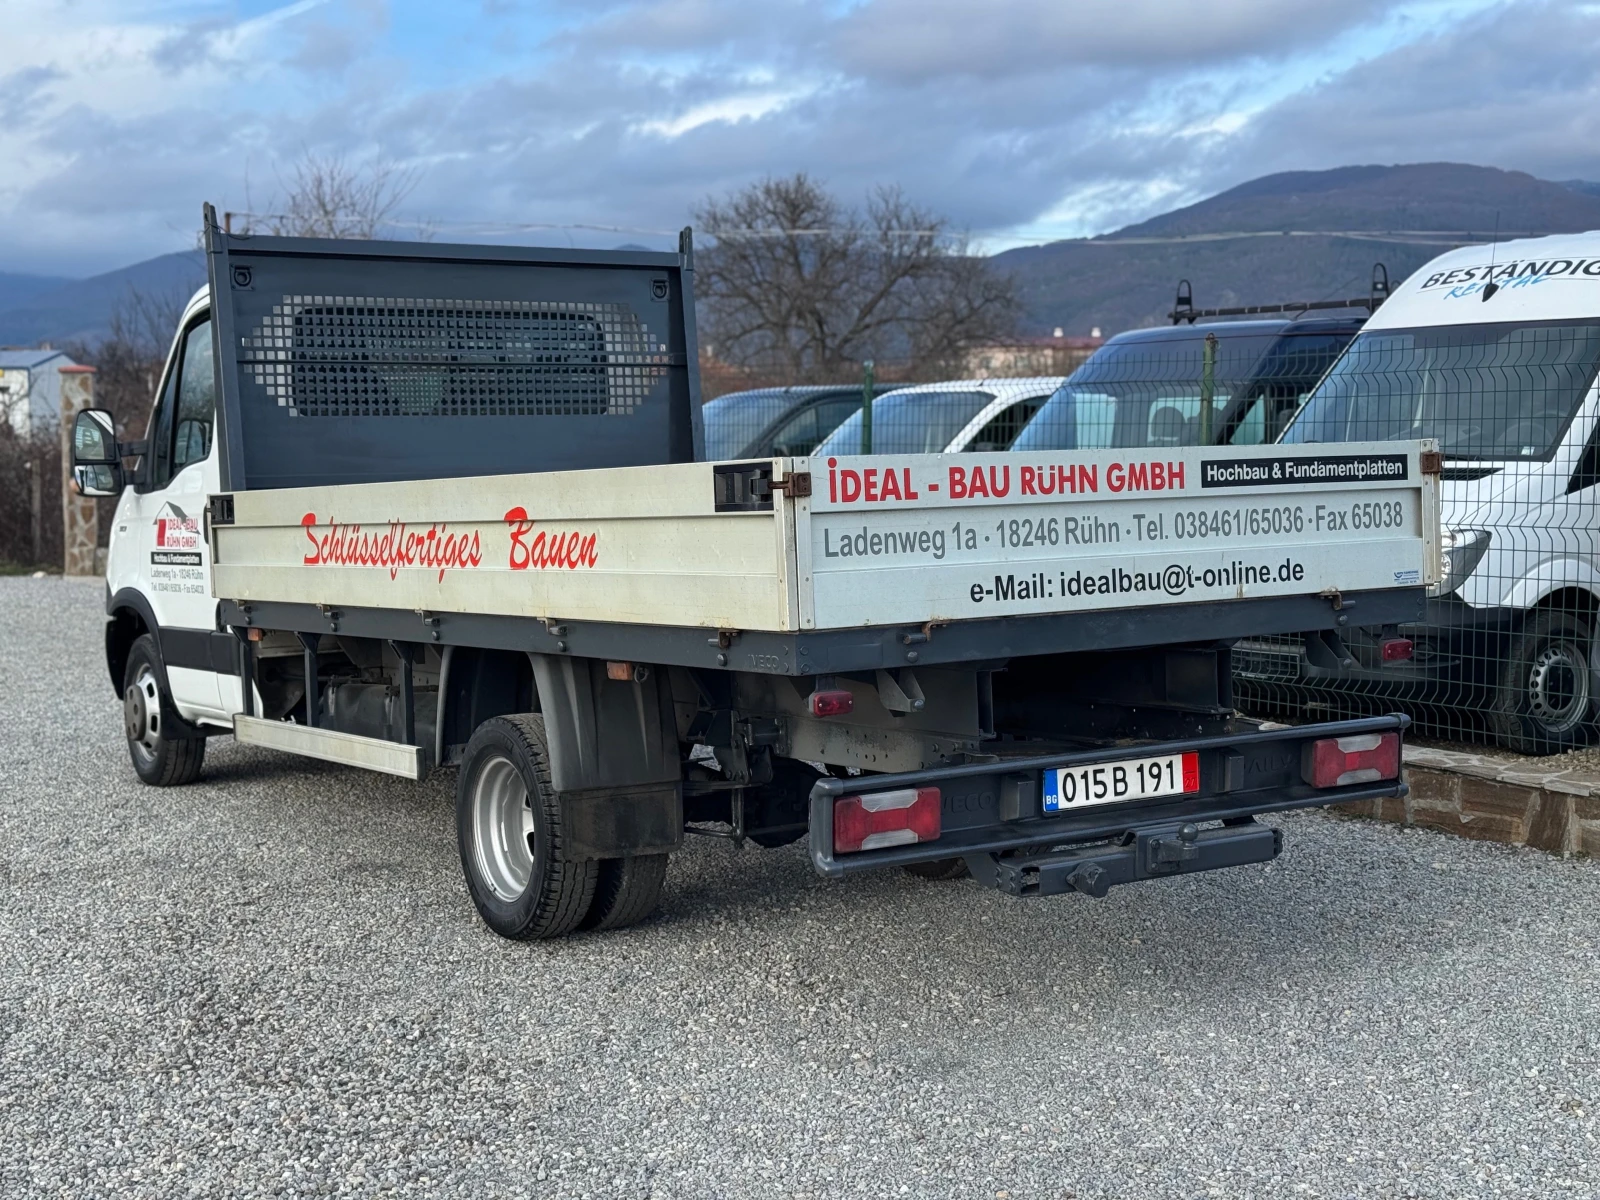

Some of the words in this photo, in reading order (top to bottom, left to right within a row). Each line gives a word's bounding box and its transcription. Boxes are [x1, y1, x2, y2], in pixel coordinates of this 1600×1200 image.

[1420, 259, 1600, 289] BESTÄNDIG
[949, 465, 1010, 499] BAU
[1106, 461, 1185, 493] GMBH
[1207, 461, 1269, 482] Hochbau
[1272, 463, 1282, 479] &
[1285, 459, 1403, 480] Fundamentplatten
[301, 512, 483, 584] Schlüsselfertiges
[504, 506, 599, 570] Bauen
[824, 526, 946, 559] Ladenweg
[952, 521, 978, 550] 1a
[996, 517, 1059, 548] 18246
[1064, 515, 1120, 545] Rühn
[1133, 513, 1169, 541] Tel.
[1174, 505, 1304, 539] 038461/65036
[1316, 504, 1348, 532] Fax
[1352, 500, 1403, 530] 65038
[970, 573, 1053, 603] e-Mail:
[1060, 558, 1305, 597] idealbau@t-online.de
[1046, 795, 1058, 805] BG
[1136, 760, 1175, 794] 191
